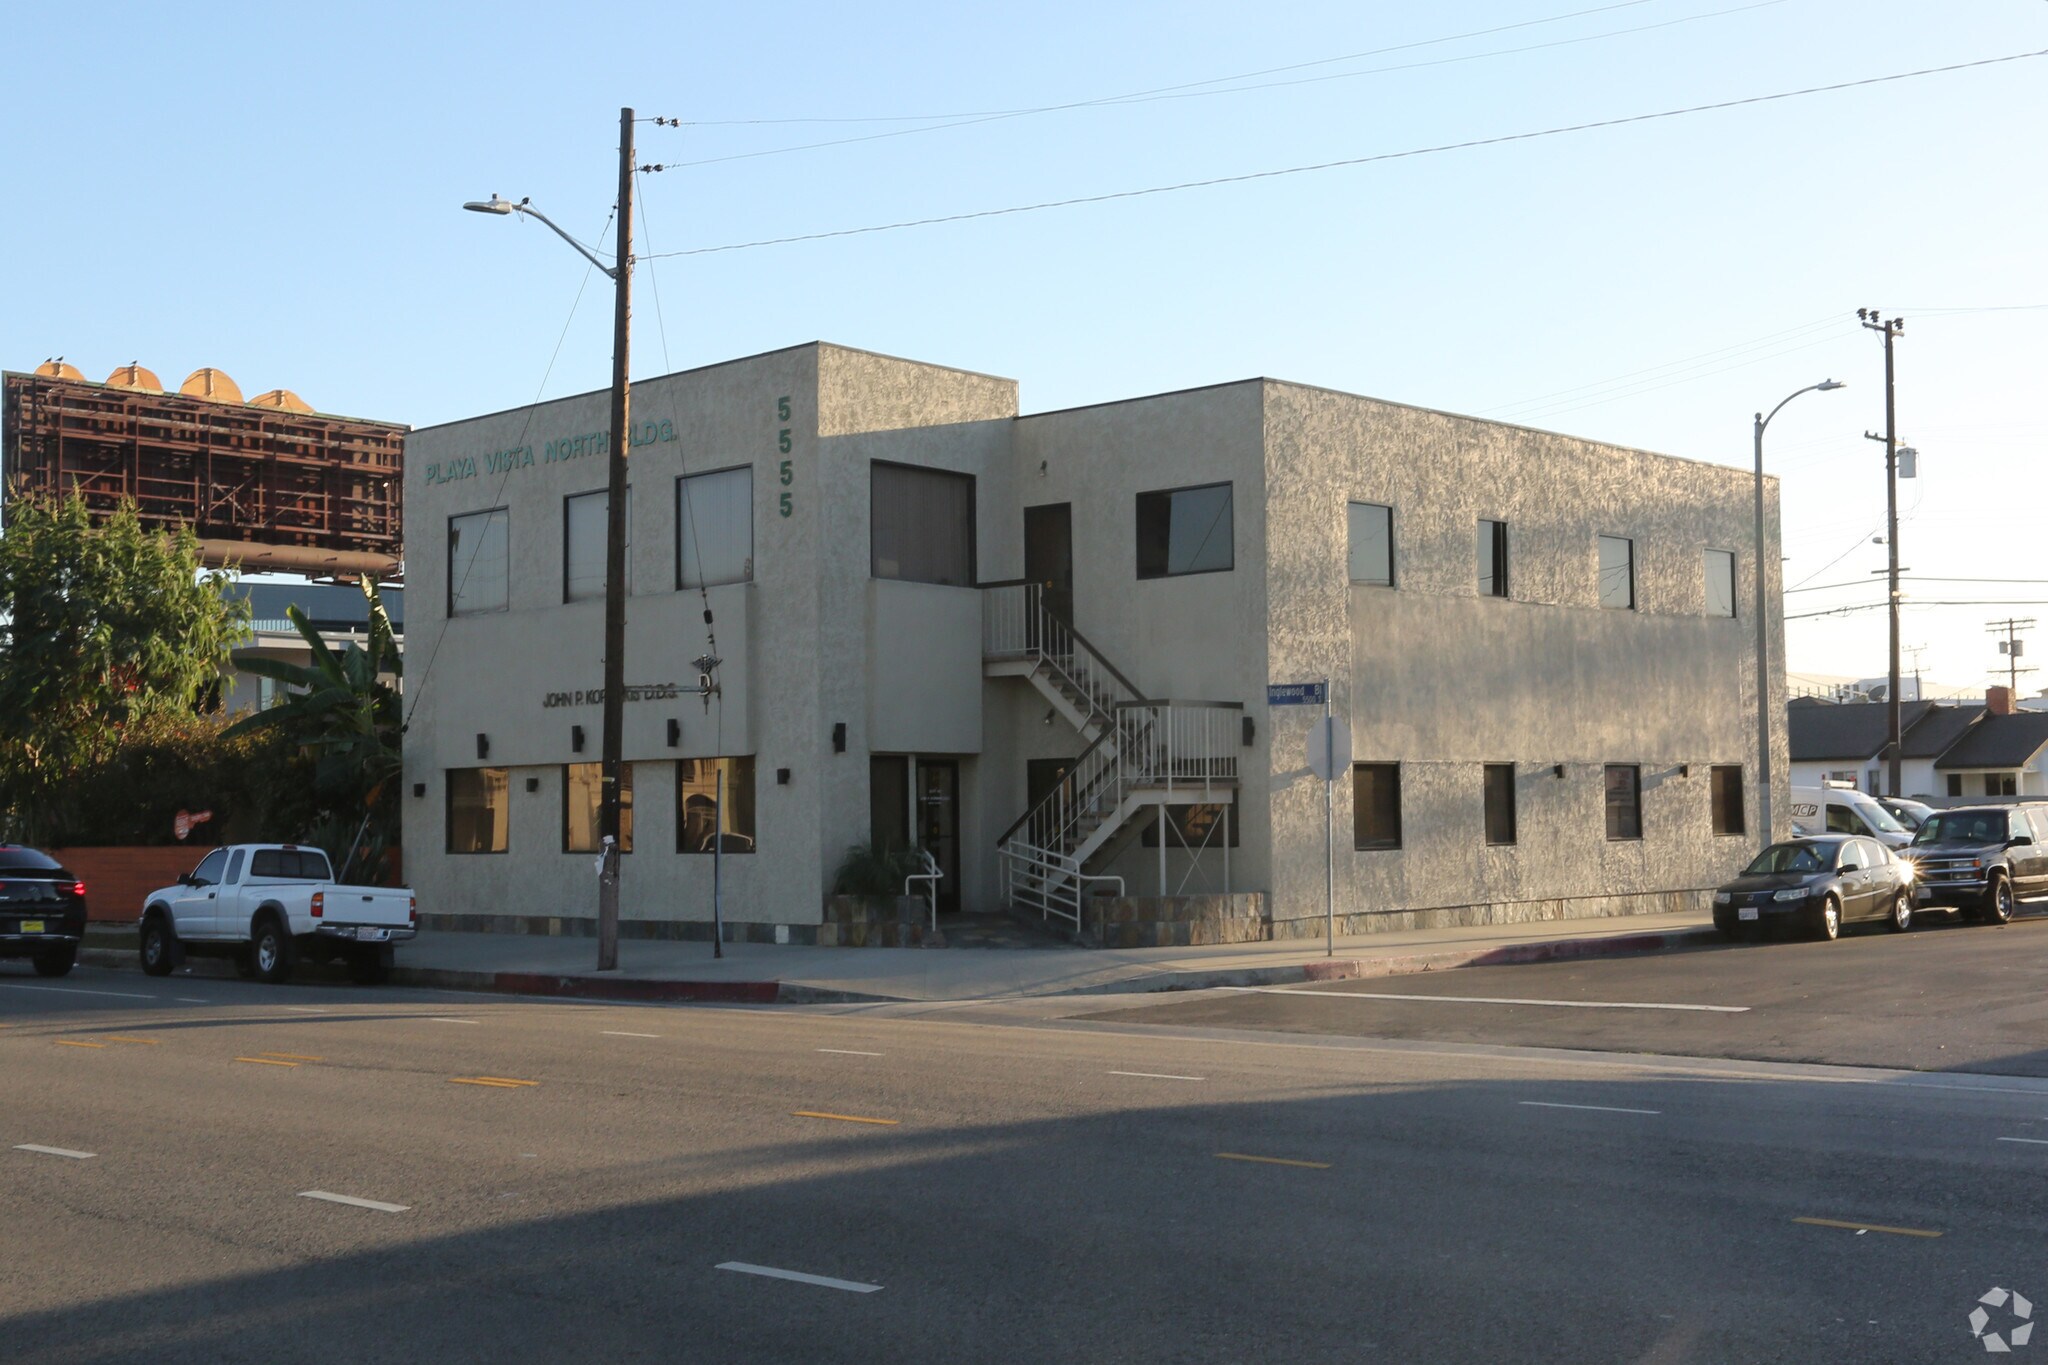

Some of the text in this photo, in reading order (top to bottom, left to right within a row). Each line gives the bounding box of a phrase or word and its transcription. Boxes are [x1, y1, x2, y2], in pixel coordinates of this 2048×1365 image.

[425, 418, 678, 485] PLAYA VISTA NORTH LDG.
[543, 691, 572, 708] JOHN
[575, 691, 585, 706] P.
[1269, 686, 1305, 700] Inglewood
